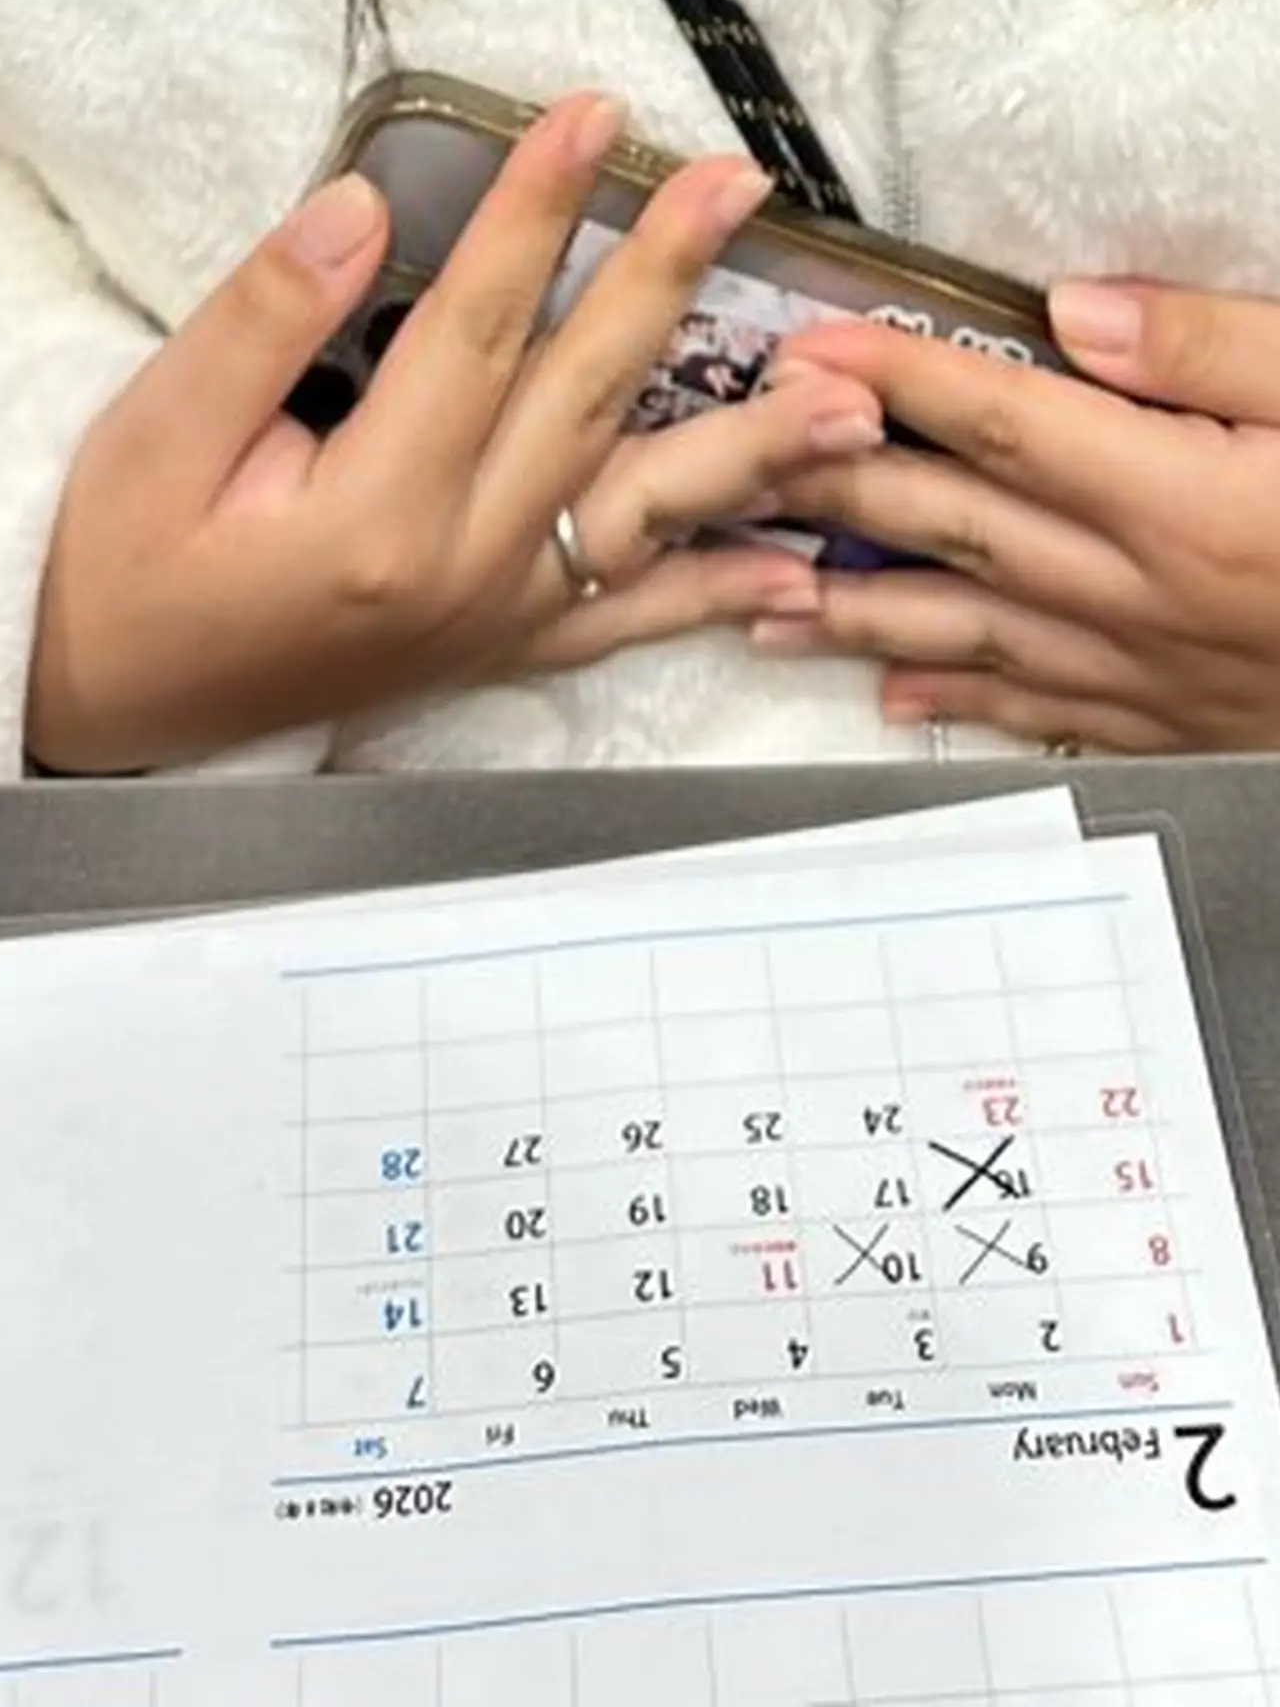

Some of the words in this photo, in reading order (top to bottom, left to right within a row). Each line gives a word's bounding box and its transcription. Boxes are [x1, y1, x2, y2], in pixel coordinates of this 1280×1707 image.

[981, 1095, 1021, 1126] 23
[1100, 1087, 1141, 1118] 22
[742, 1111, 784, 1144] 25
[862, 1103, 902, 1136] 24
[503, 1134, 543, 1168] 27
[621, 1119, 663, 1154] 26
[381, 1148, 423, 1181] 28
[1114, 1159, 1153, 1192] 15
[750, 1185, 790, 1217] 18
[873, 1178, 912, 1209] 17
[504, 1207, 547, 1242] 20
[628, 1194, 666, 1227] 19
[386, 1221, 424, 1254] 21
[1148, 1232, 1171, 1266] 8
[760, 1257, 798, 1291] 11
[881, 1251, 922, 1284] 10
[1025, 1242, 1050, 1275] 9
[508, 1281, 549, 1317] 13
[633, 1268, 674, 1303] 12
[384, 1297, 422, 1331] 14
[1168, 1313, 1184, 1344] 1
[912, 1327, 934, 1361] 3
[1039, 1320, 1063, 1352] 2
[659, 1346, 682, 1379] 5
[787, 1338, 809, 1369] 4
[406, 1375, 427, 1408] 7
[531, 1360, 556, 1393] 6
[987, 1380, 1037, 1403] Mon
[732, 1397, 781, 1420] Wed
[865, 1388, 905, 1412] Tue
[484, 1423, 515, 1447] Fri
[607, 1408, 650, 1429] Thu
[352, 1437, 388, 1459] Sat
[1012, 1426, 1162, 1462] February
[1173, 1422, 1236, 1514] 2
[372, 1479, 454, 1519] 2026
